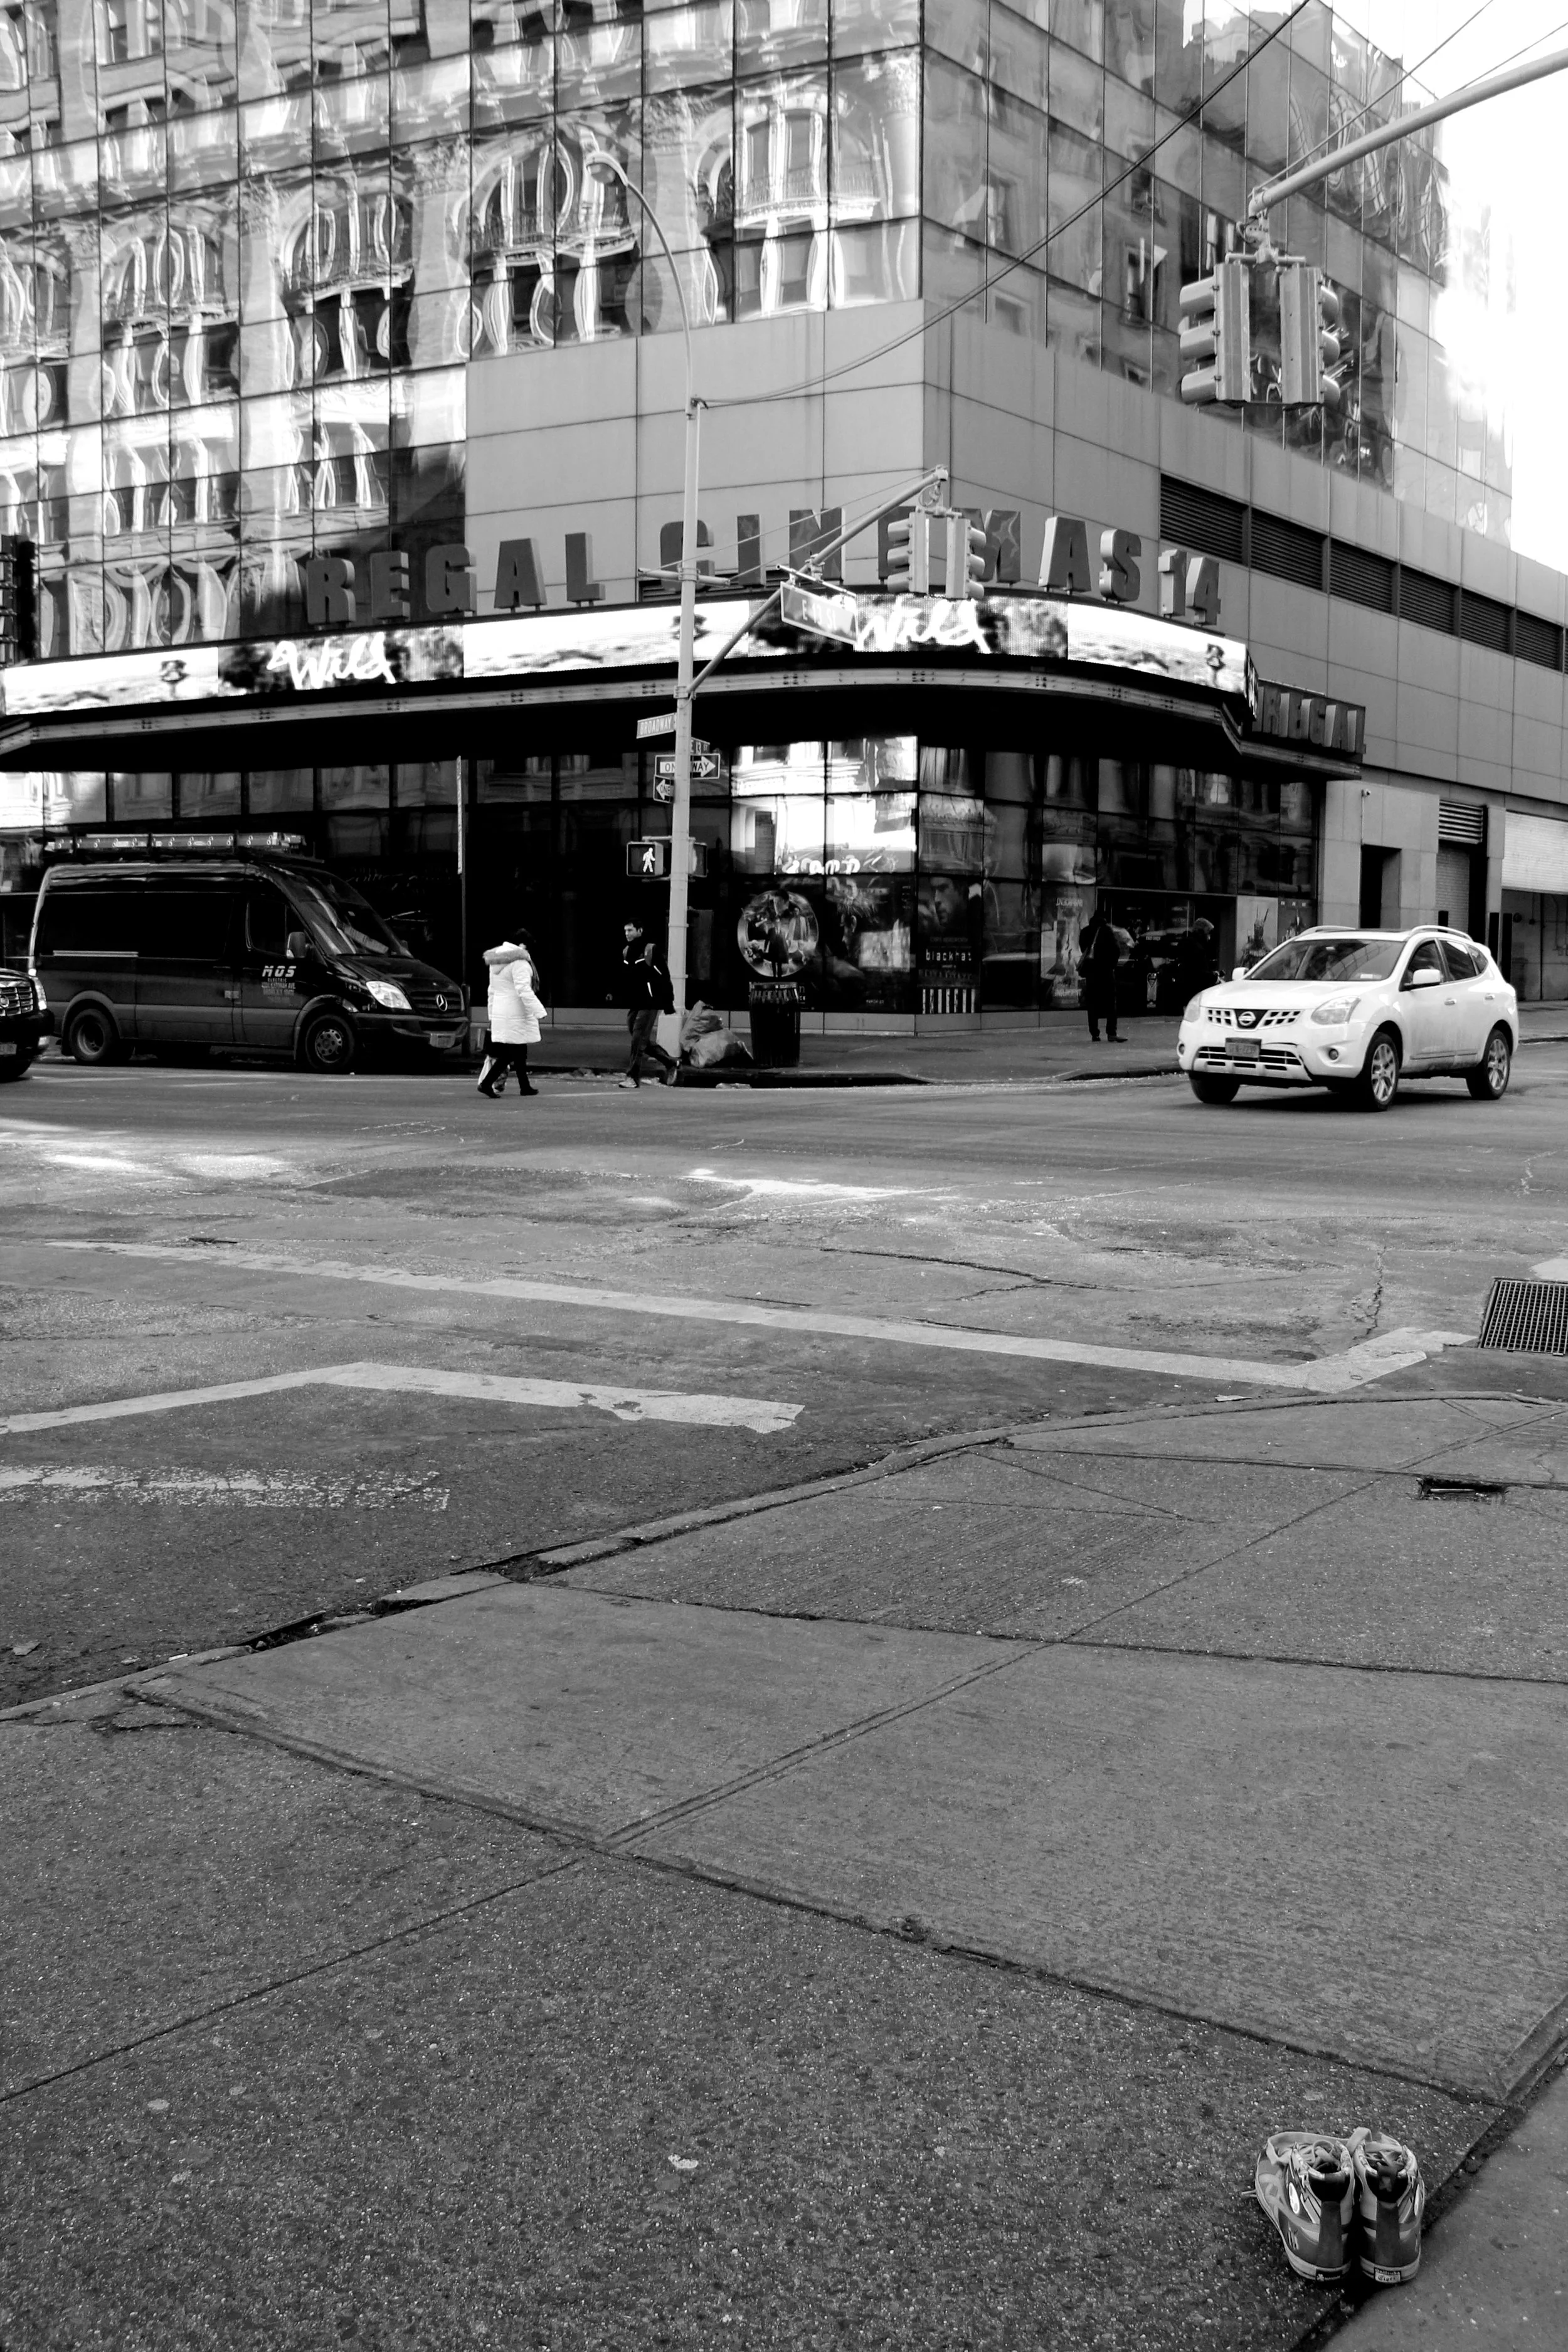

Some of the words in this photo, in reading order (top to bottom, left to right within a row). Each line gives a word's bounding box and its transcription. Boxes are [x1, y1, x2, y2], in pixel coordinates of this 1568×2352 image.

[307, 531, 606, 625] REGAL
[1158, 549, 1221, 626] 14
[802, 599, 808, 621] E
[267, 632, 395, 690] Wild
[640, 716, 672, 735] BROADWAY
[696, 741, 702, 755] 13
[692, 762, 709, 771] WAY
[660, 784, 671, 795] ONE
[262, 965, 297, 977] MOS
